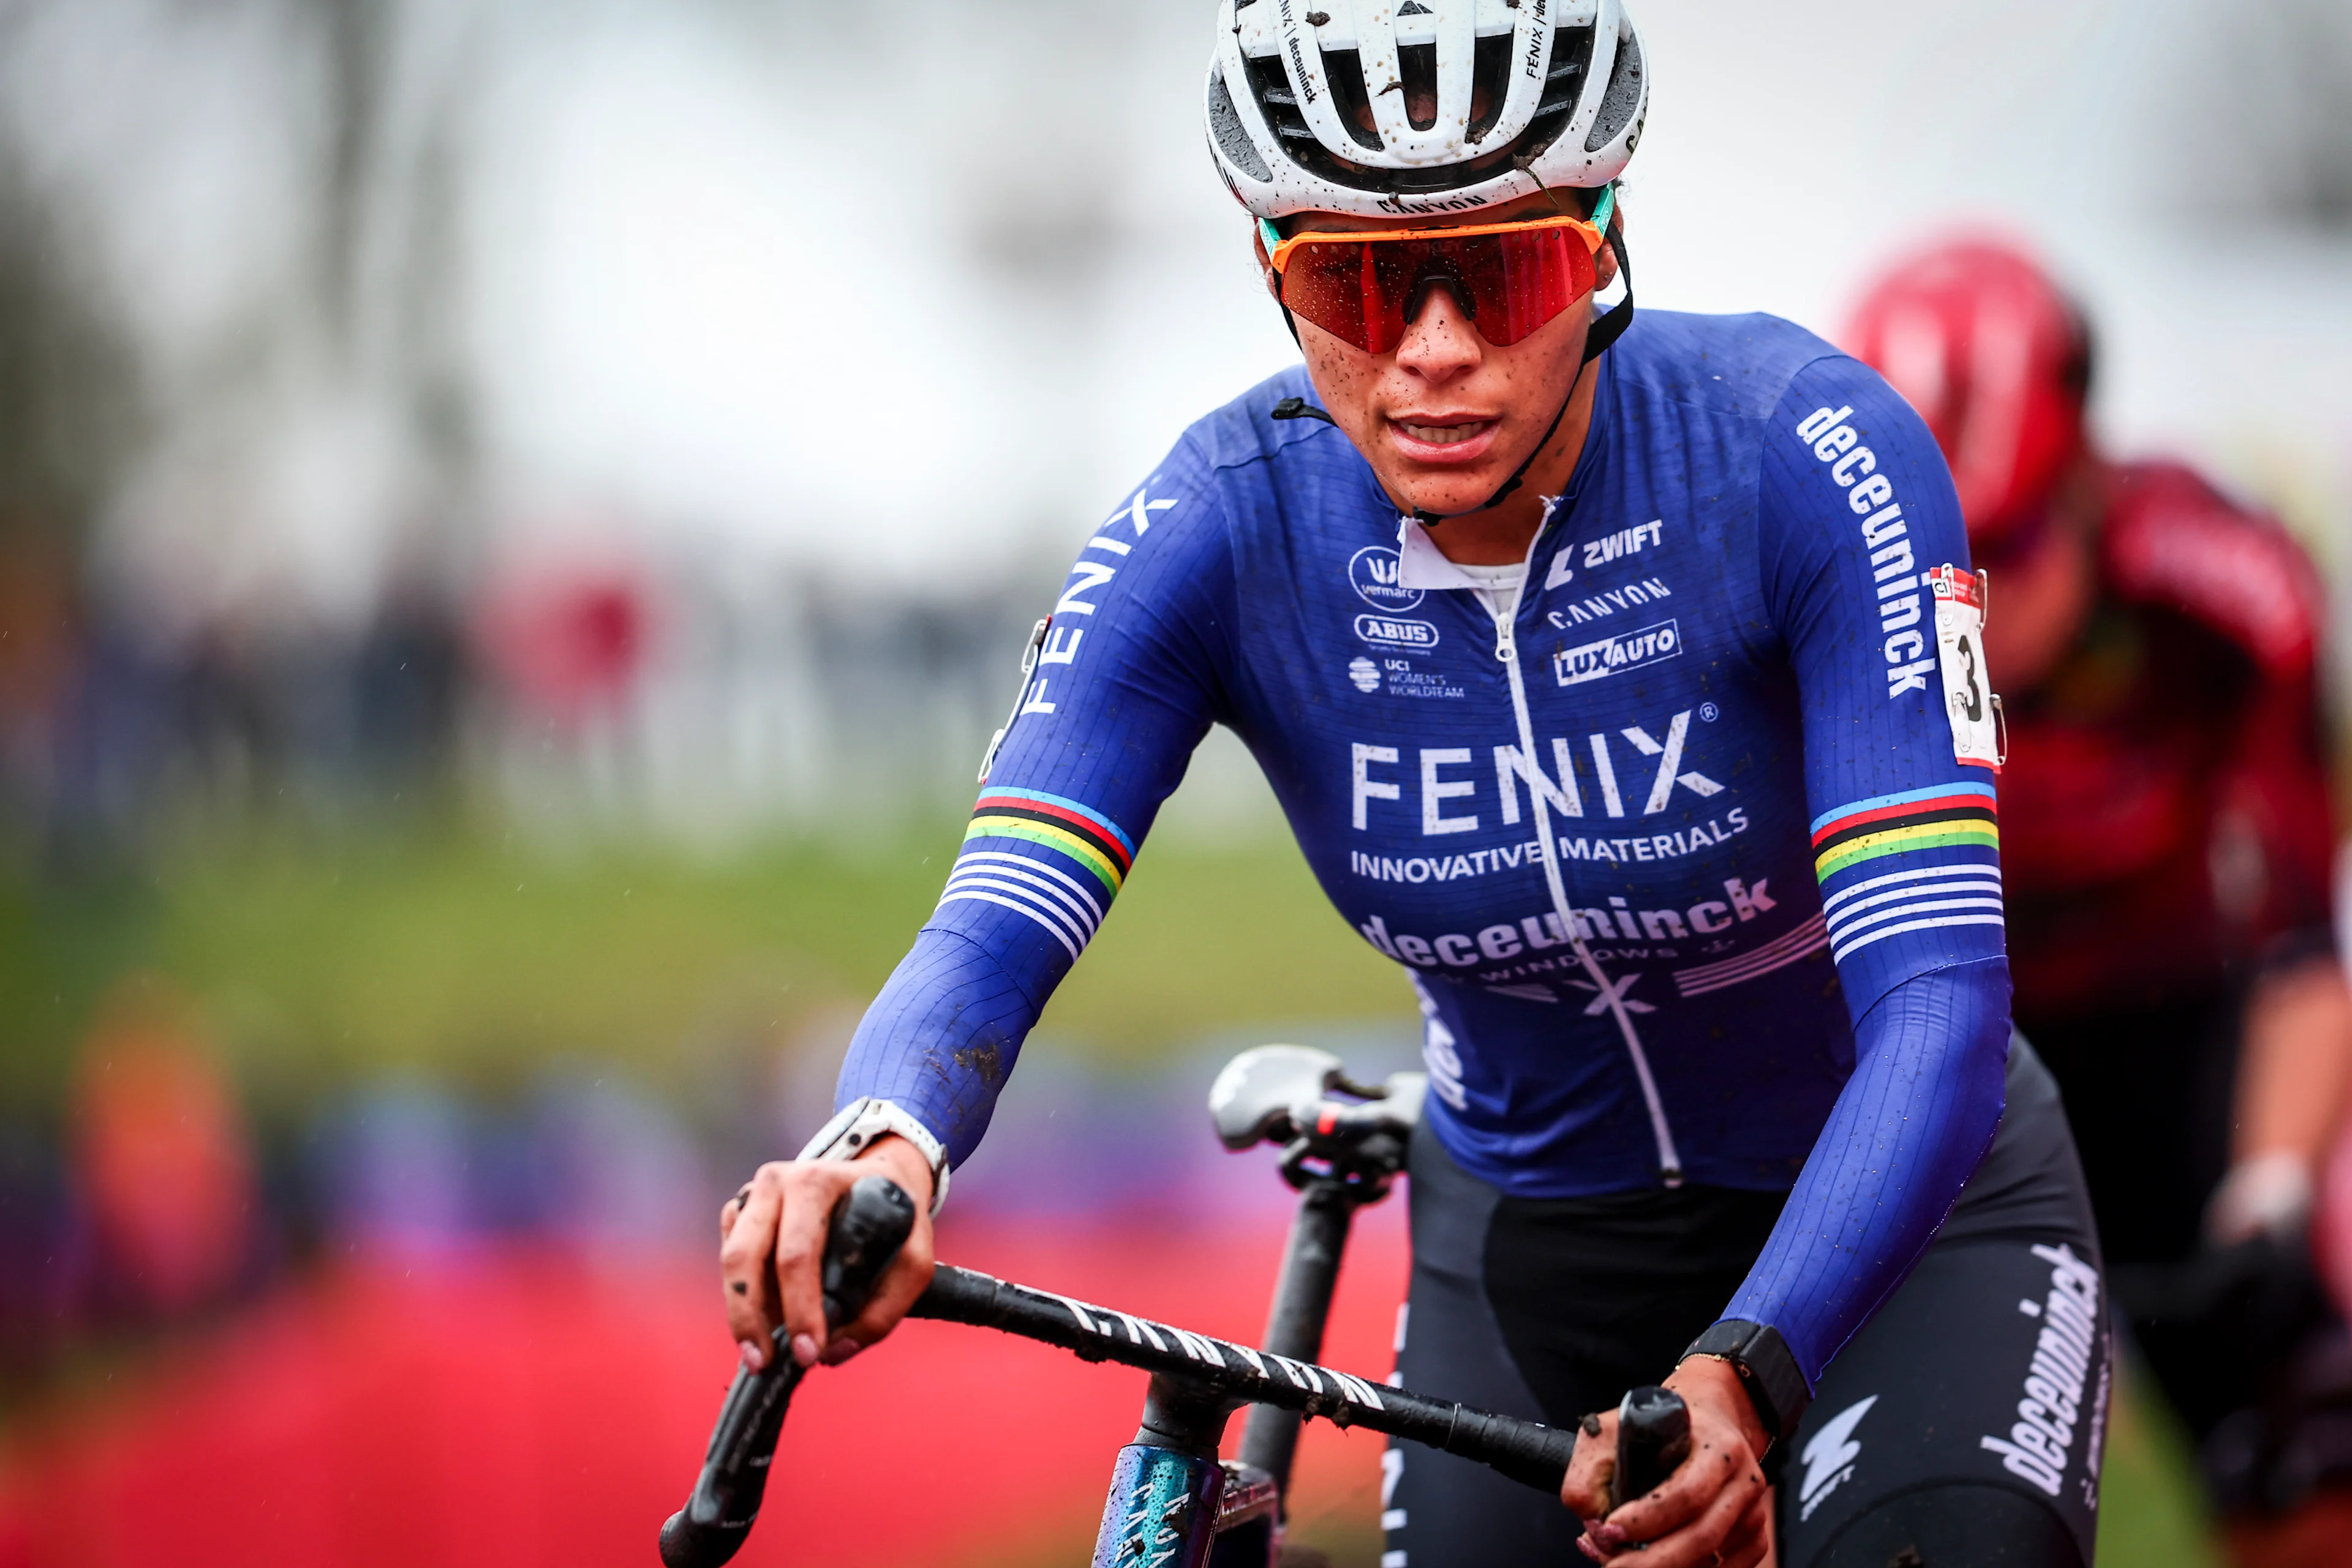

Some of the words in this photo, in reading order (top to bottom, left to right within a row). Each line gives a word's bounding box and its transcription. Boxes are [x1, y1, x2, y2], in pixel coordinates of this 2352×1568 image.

[1279, 0, 1292, 27] NIX
[1289, 37, 1316, 105] deceuninck
[1526, 27, 1544, 78] FENIX
[1377, 195, 1487, 213] CANYON
[1583, 519, 1662, 568] ZWIFT
[1796, 405, 1936, 700] deceuninck
[1020, 488, 1179, 715] FENIX
[1361, 584, 1415, 600] vermarc
[1547, 578, 1672, 629] CANYON
[1366, 620, 1428, 642] ABUS
[1385, 659, 1409, 671] UCI
[1388, 673, 1446, 686] WOMEN'S
[1958, 635, 1982, 722] 3
[1389, 685, 1464, 698] WORLDTEAM
[1352, 710, 1725, 837] FENIX
[1351, 840, 1544, 883] INNOVATIVE
[1559, 807, 1749, 861] MATERIALS
[1362, 877, 1777, 967] deceuninck
[1479, 948, 1679, 982] WINDOWS
[1981, 1243, 2099, 1496] deceuninck
